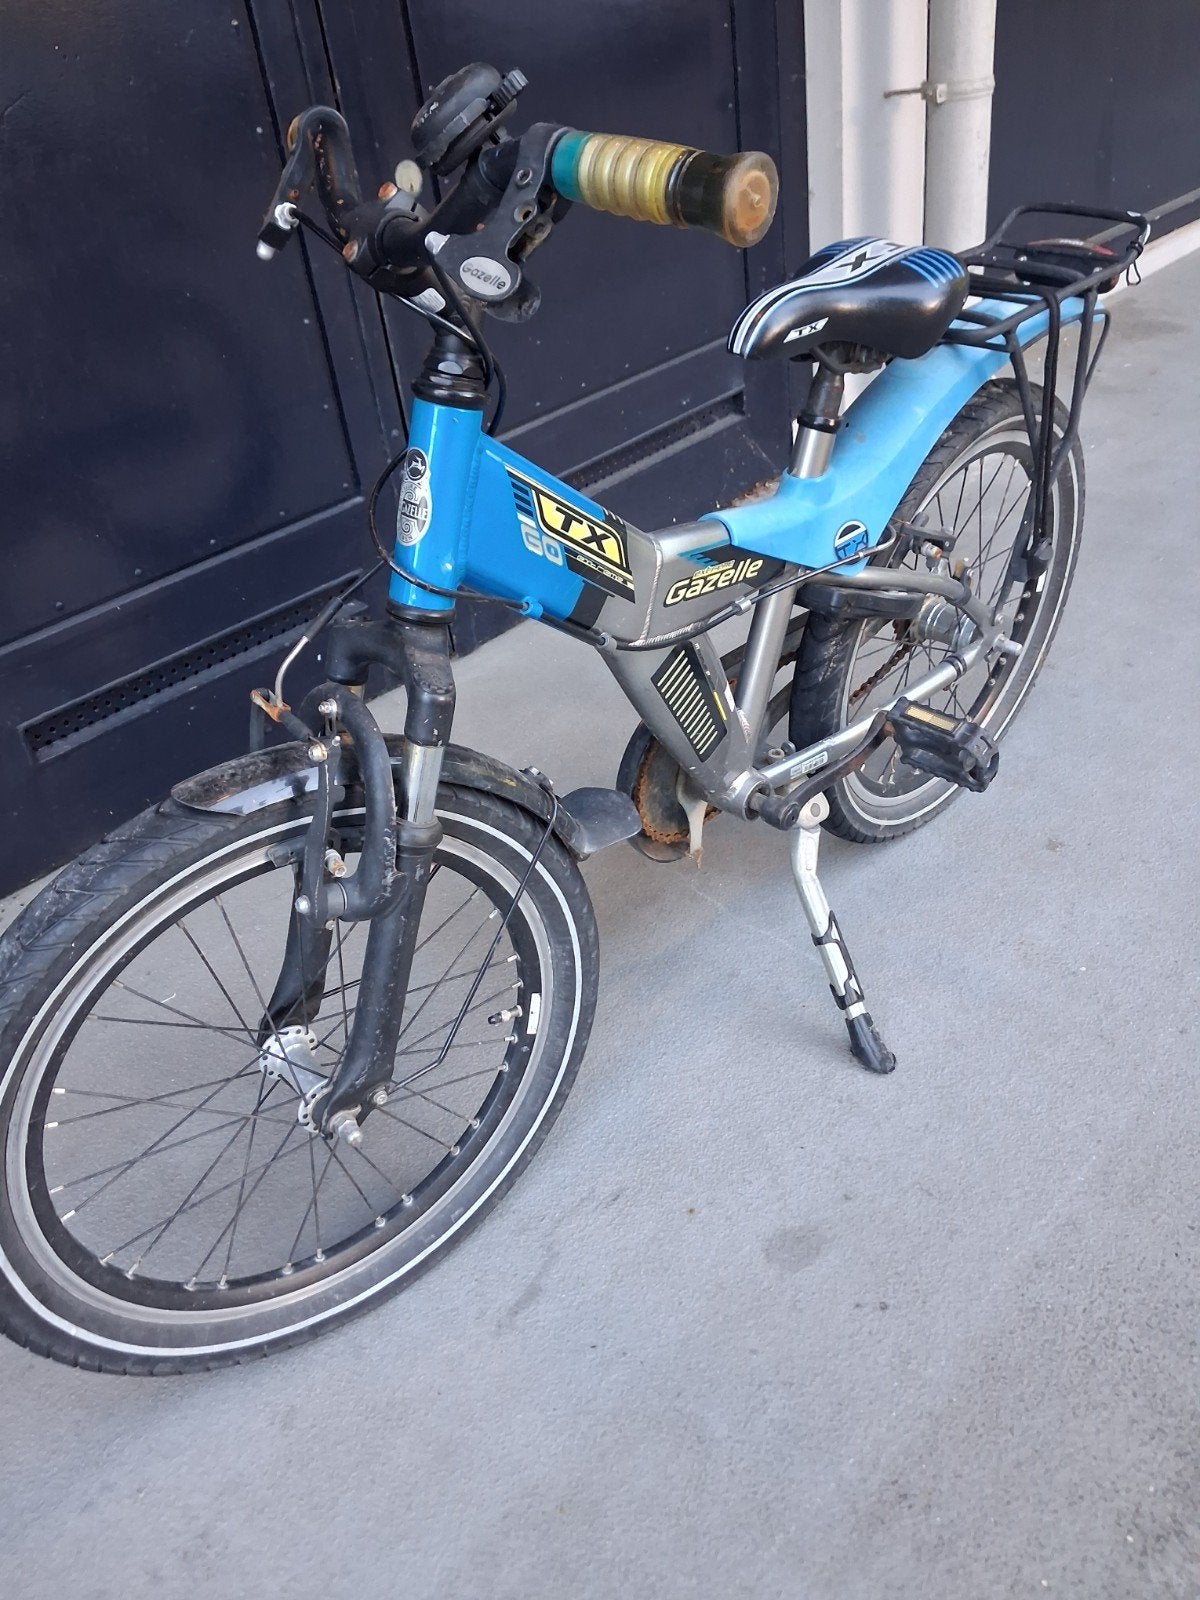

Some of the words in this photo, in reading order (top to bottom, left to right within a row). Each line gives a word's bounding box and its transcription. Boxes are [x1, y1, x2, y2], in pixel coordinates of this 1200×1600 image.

[461, 262, 506, 290] Gazelle
[555, 506, 611, 554] TX
[665, 559, 764, 606] Gazelle
